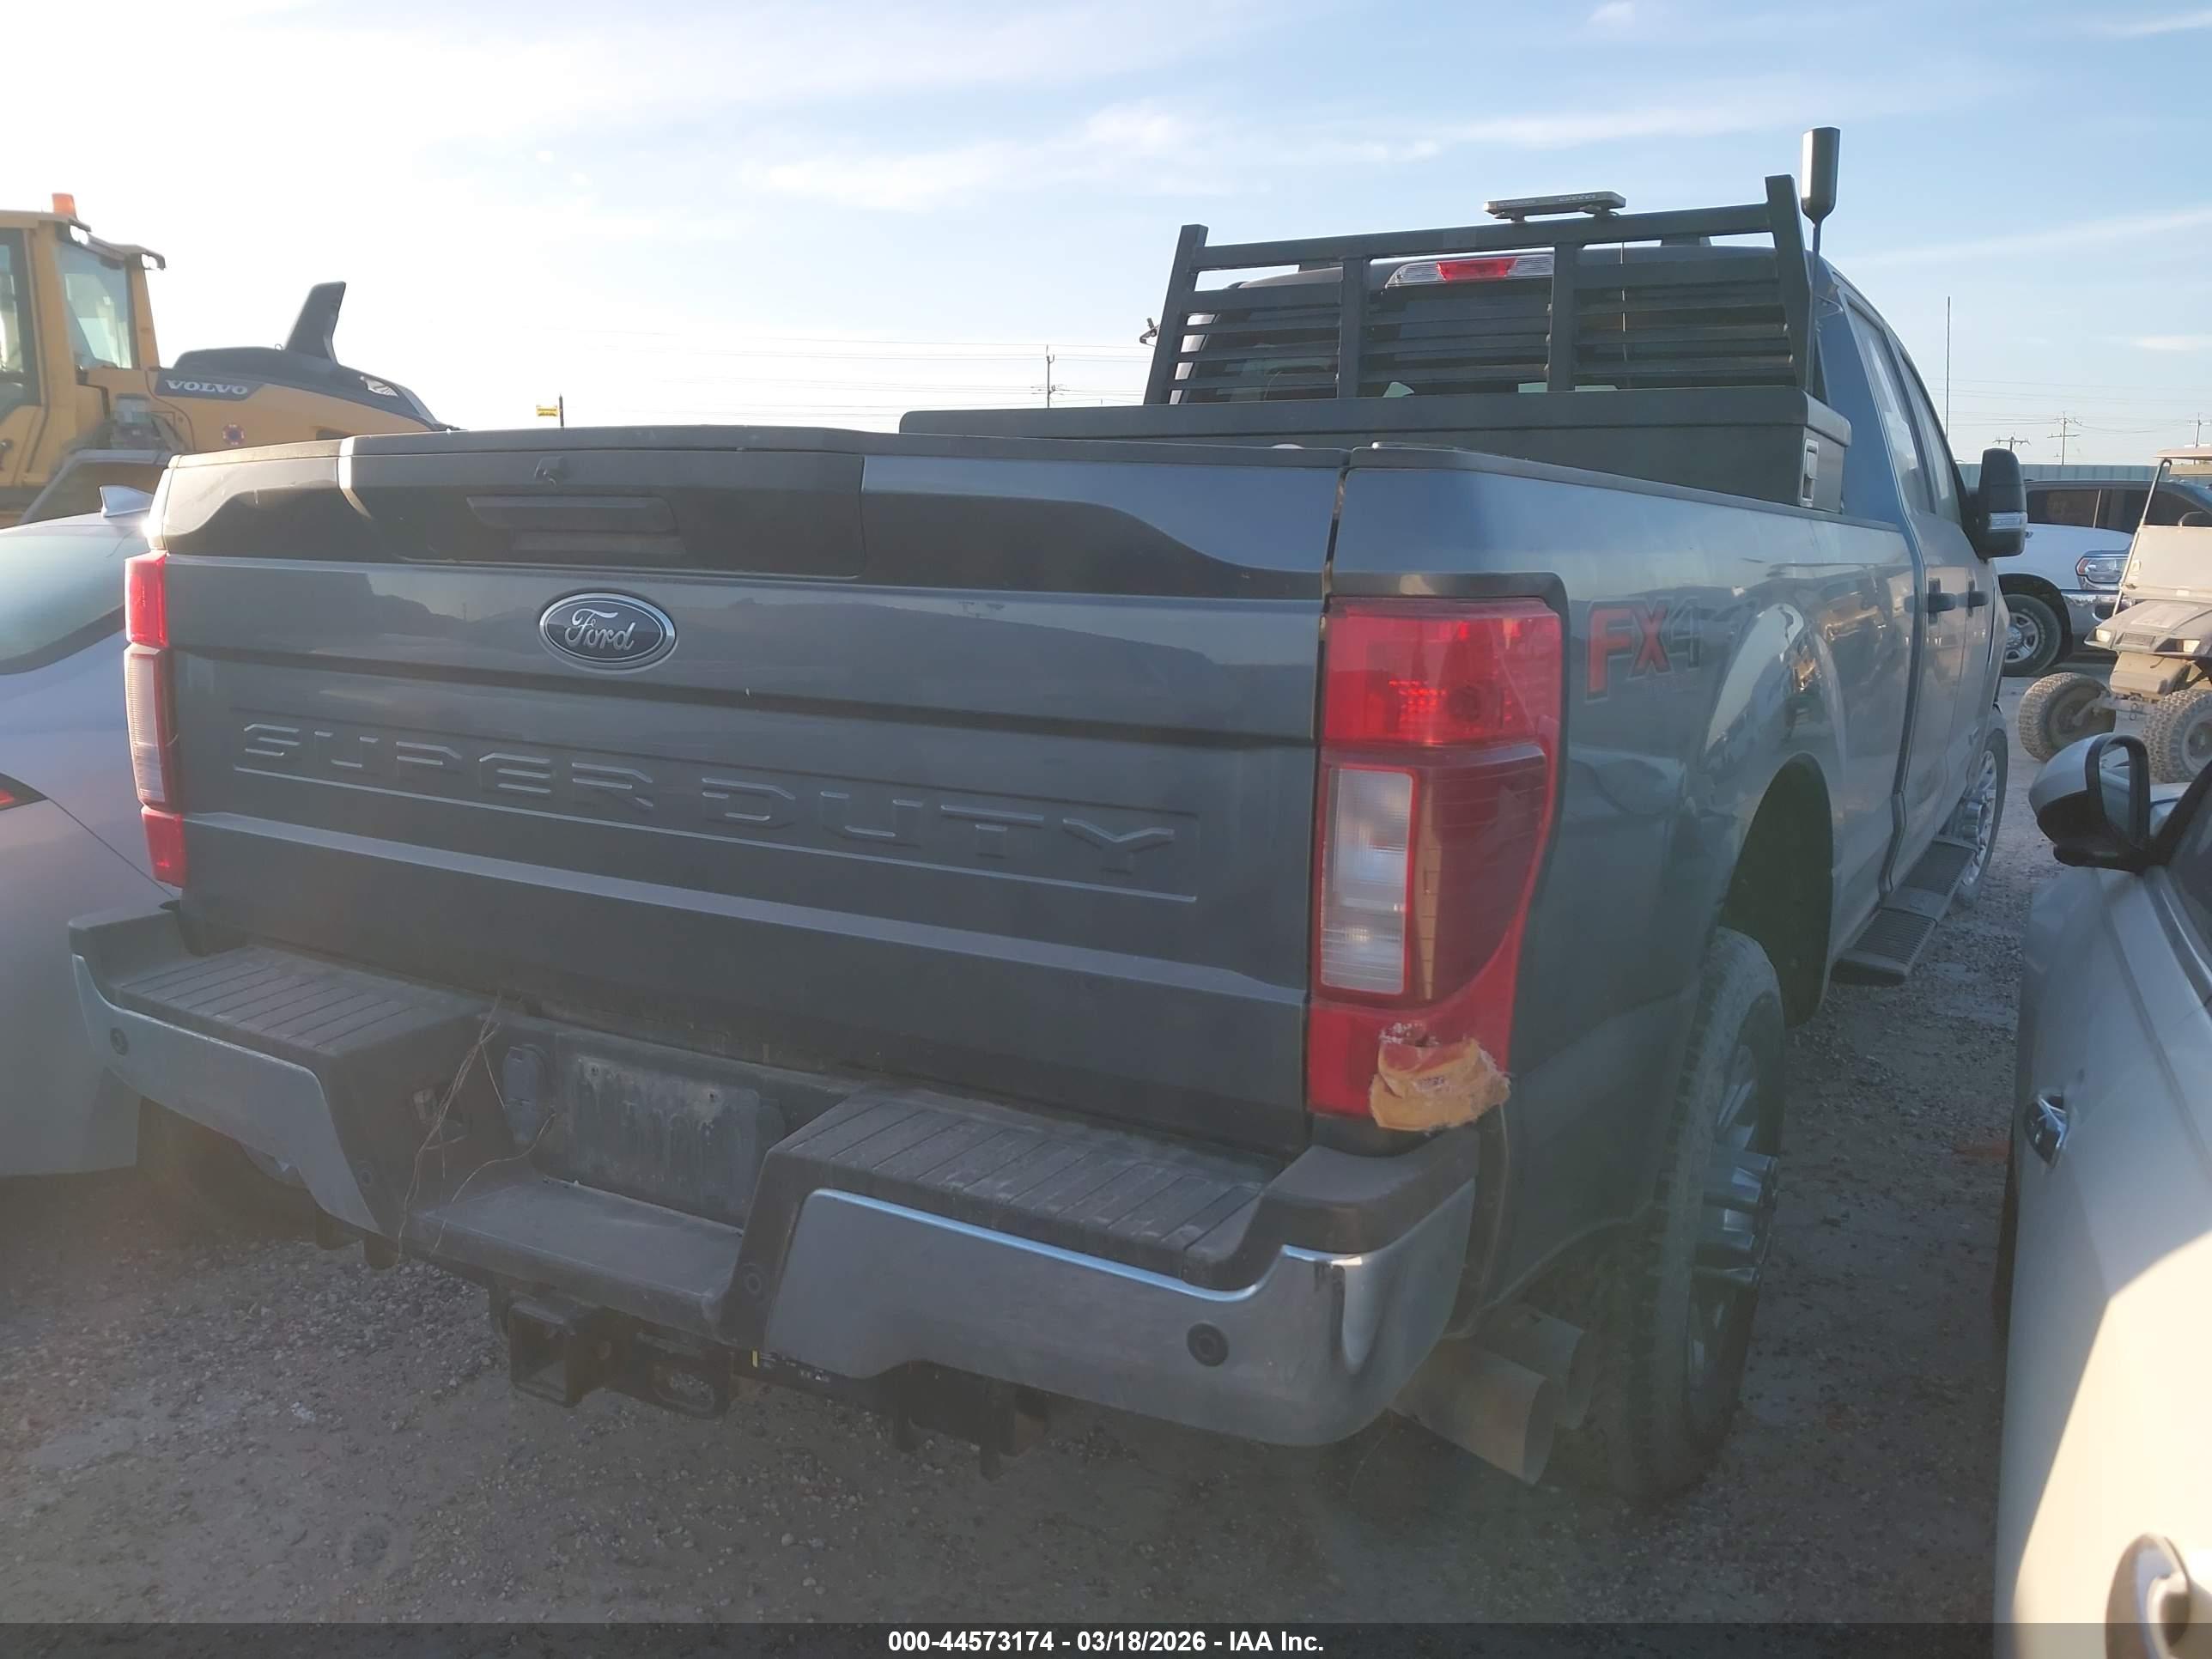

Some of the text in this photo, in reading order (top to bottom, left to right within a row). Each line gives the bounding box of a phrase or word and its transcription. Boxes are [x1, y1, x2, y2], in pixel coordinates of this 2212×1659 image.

[165, 380, 248, 395] VOLVO
[564, 608, 636, 650] Ford
[1586, 599, 1700, 702] FX4
[243, 722, 1176, 874] SUPER DUTY
